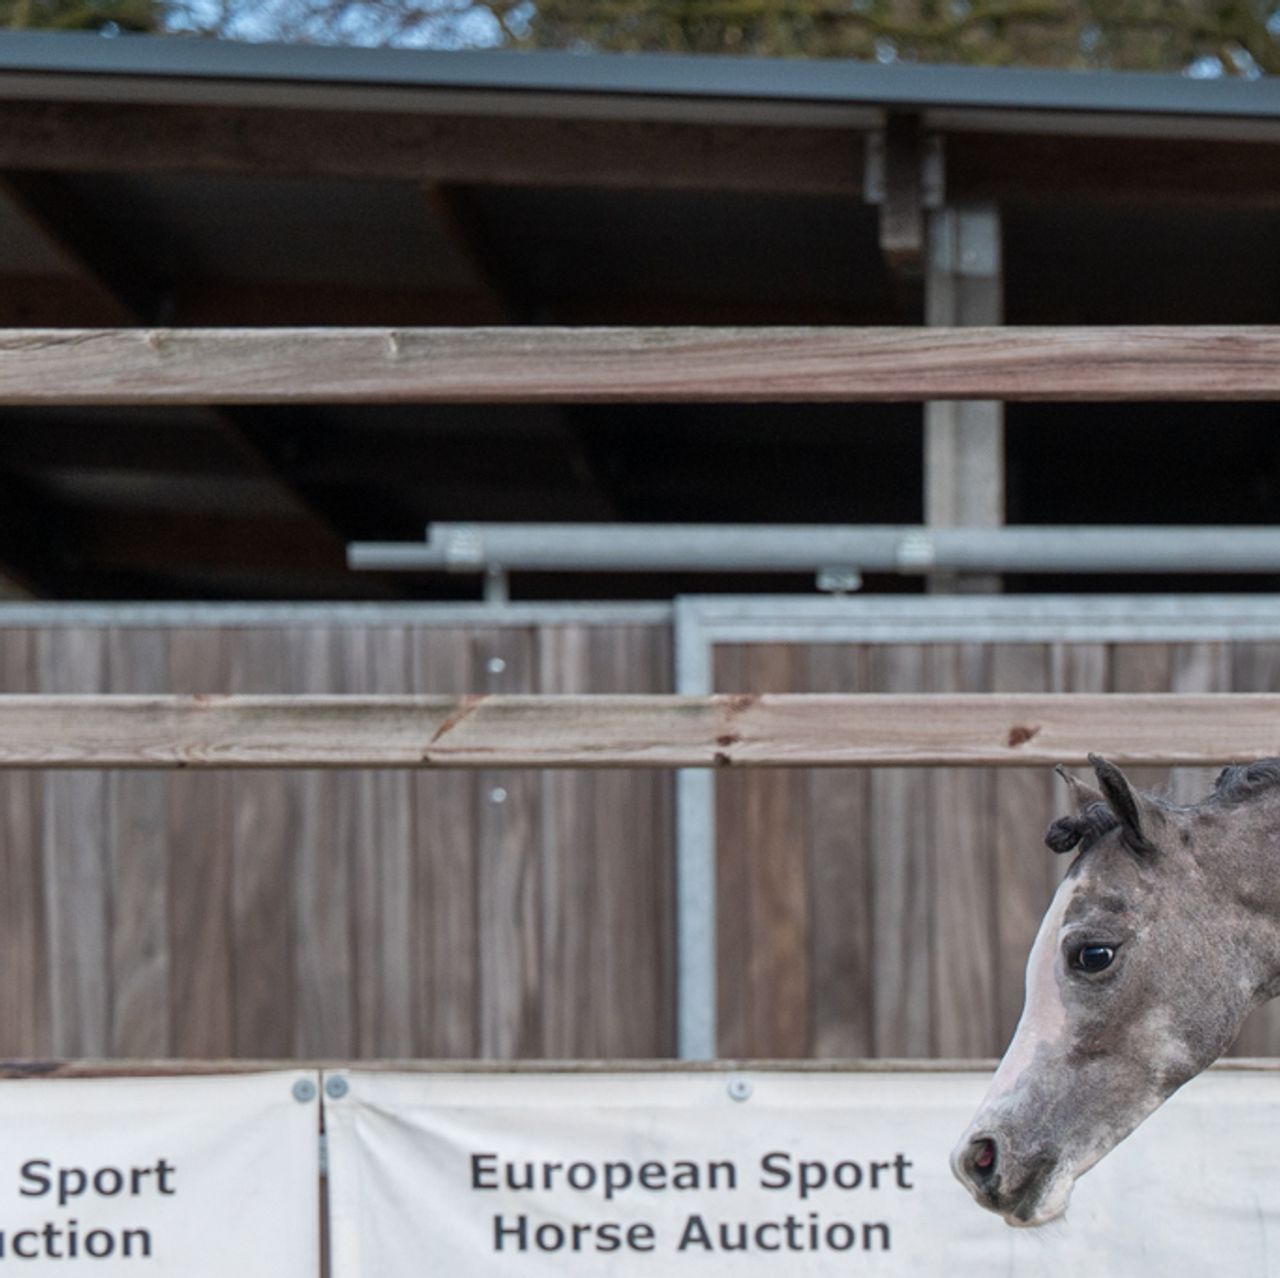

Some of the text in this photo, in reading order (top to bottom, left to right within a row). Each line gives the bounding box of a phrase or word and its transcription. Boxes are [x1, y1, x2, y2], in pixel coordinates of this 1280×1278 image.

[20, 1158, 176, 1206] Sport
[470, 1152, 913, 1200] European Sport
[0, 1219, 151, 1259] ction
[493, 1212, 890, 1252] Horse Auction
